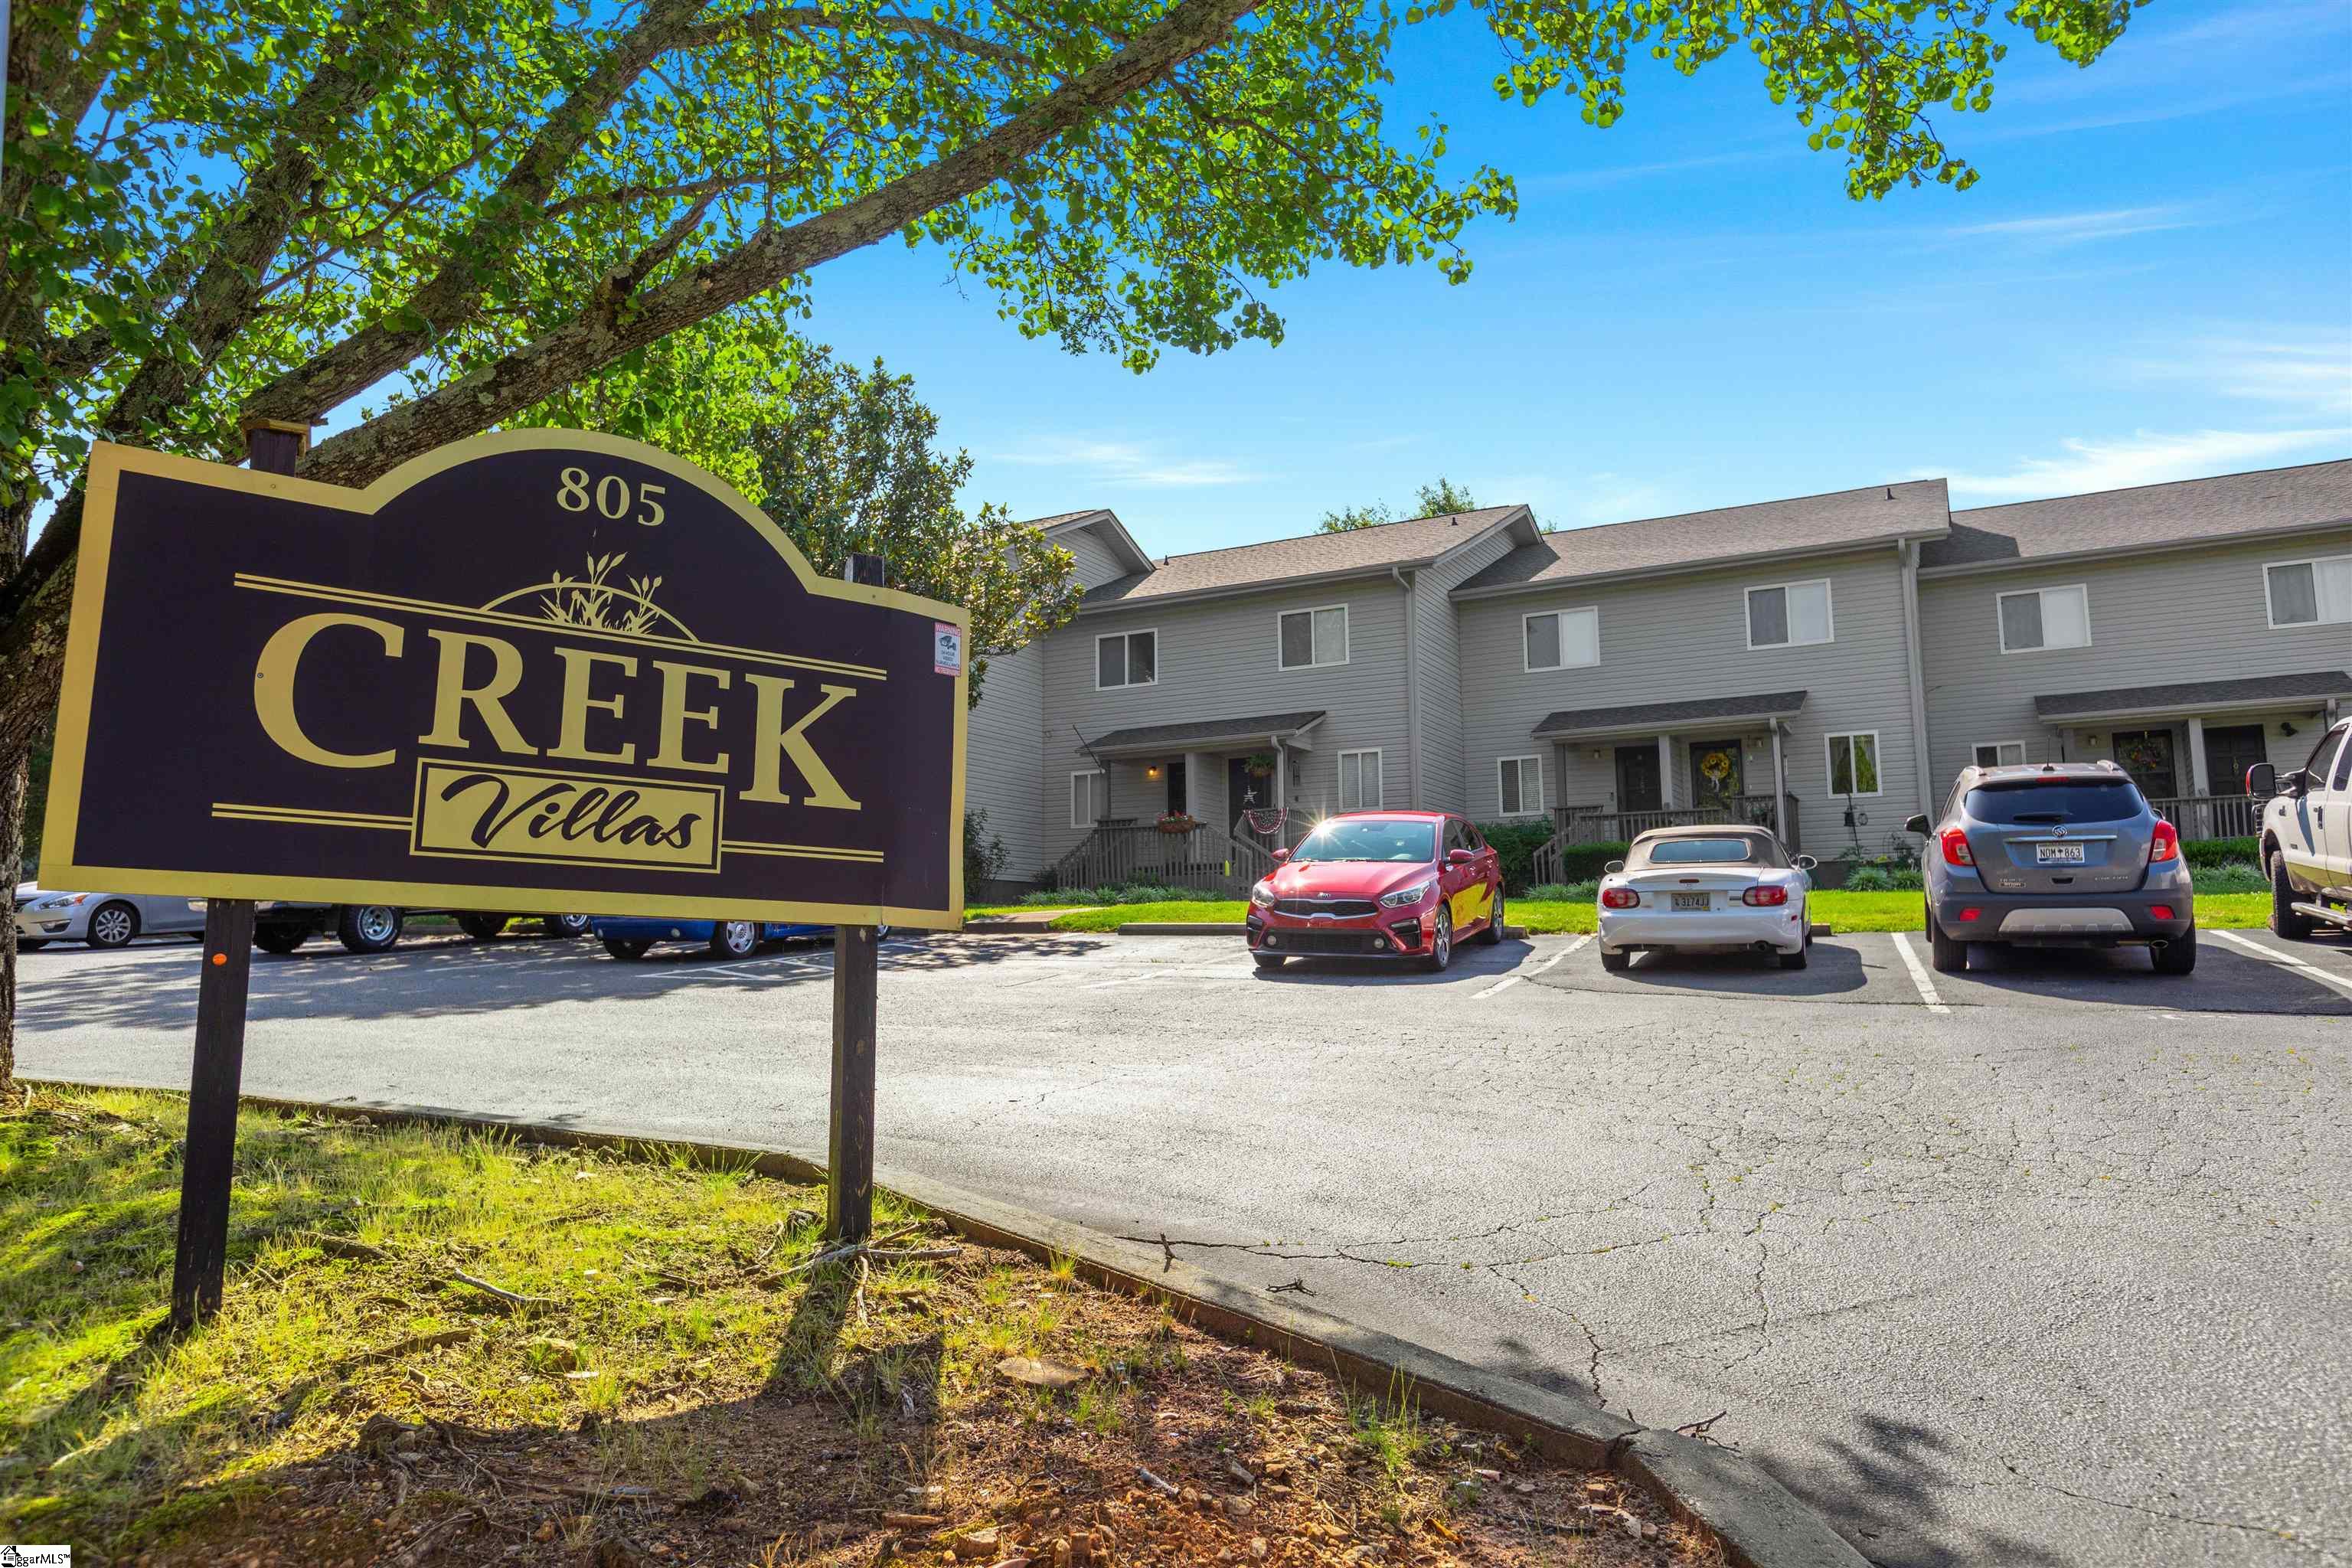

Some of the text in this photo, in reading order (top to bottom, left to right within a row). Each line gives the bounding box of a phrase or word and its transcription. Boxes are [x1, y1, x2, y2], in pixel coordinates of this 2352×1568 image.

[556, 467, 667, 527] 805
[253, 612, 861, 812] CREEK
[440, 773, 703, 850] Villas
[2040, 848, 2081, 858] NOM 863
